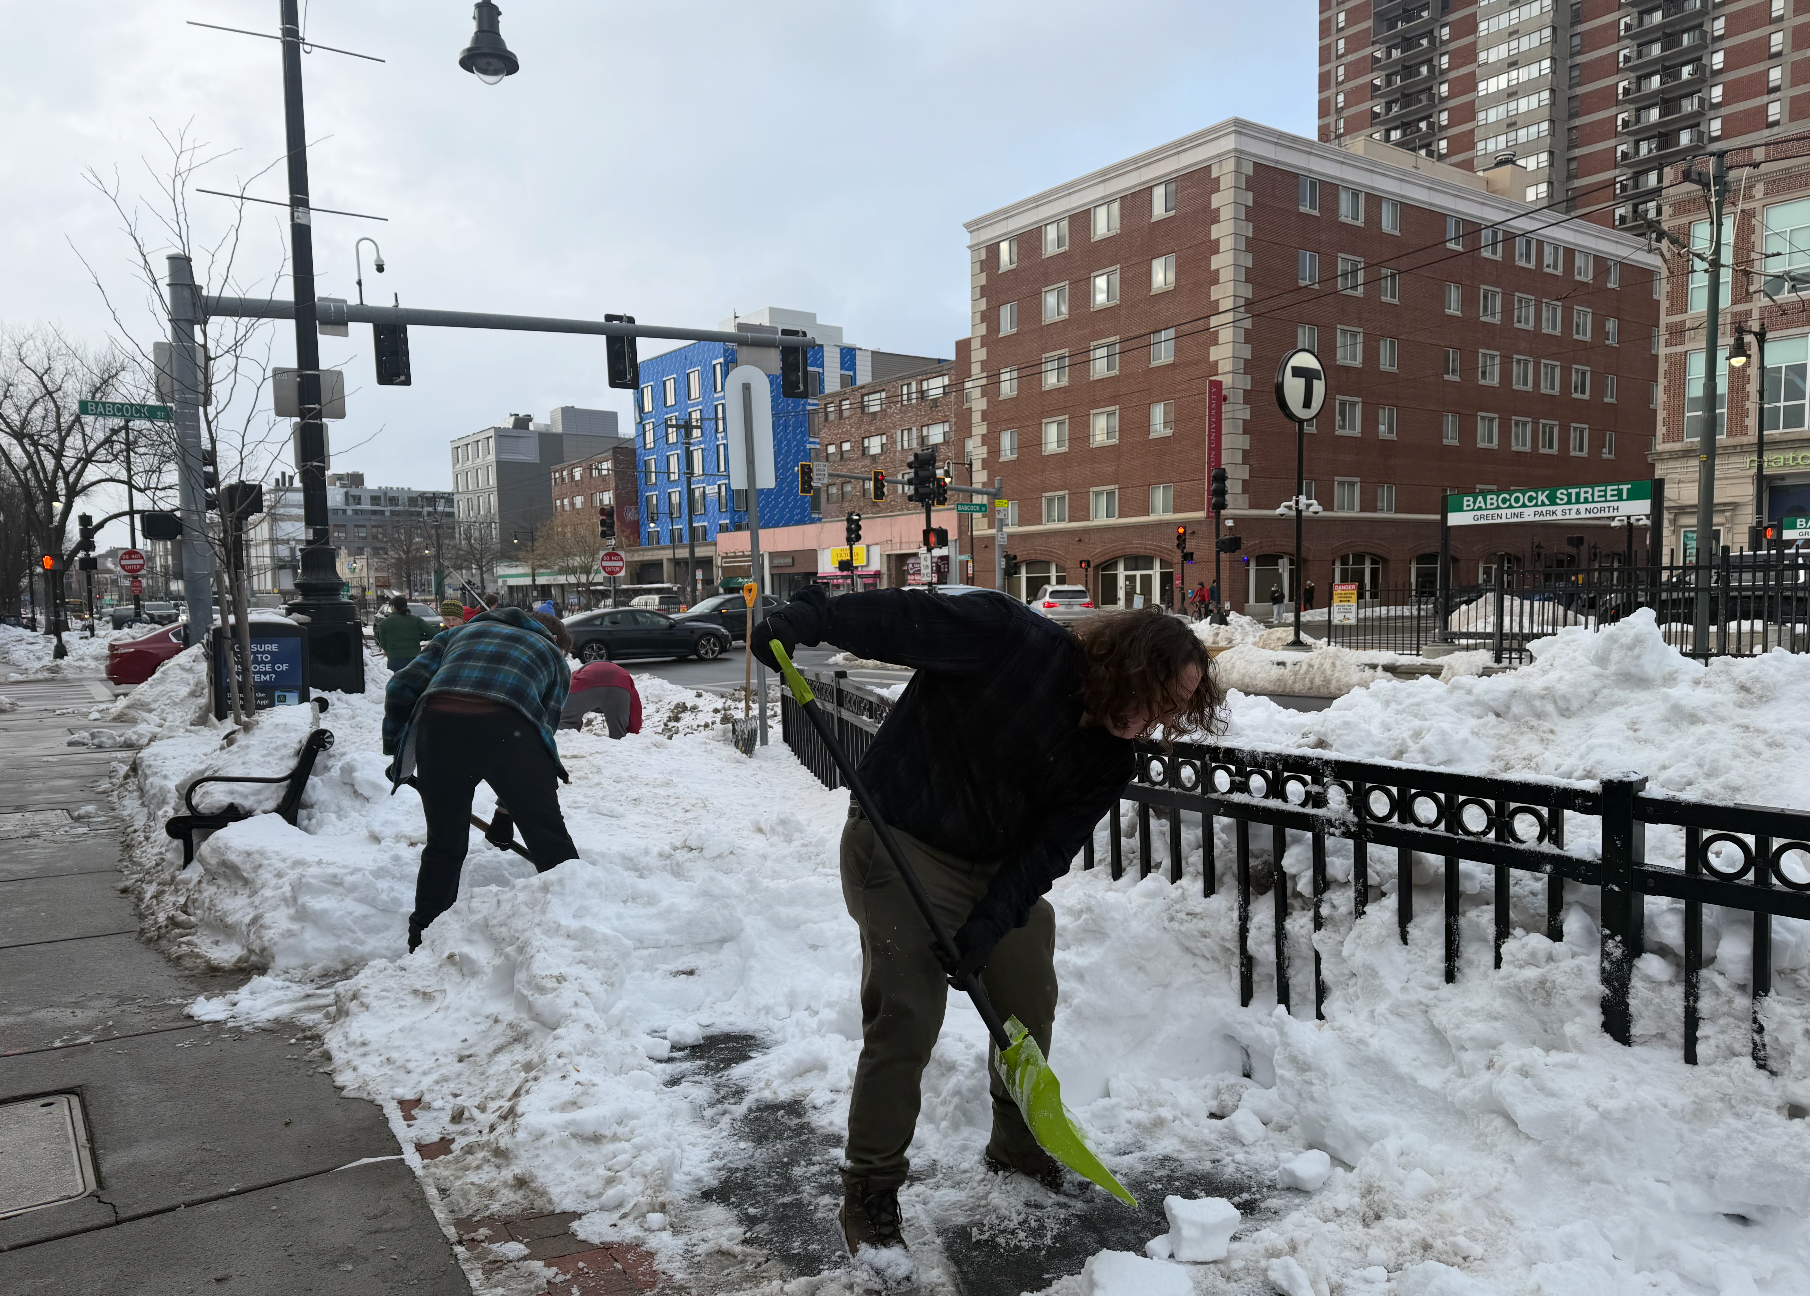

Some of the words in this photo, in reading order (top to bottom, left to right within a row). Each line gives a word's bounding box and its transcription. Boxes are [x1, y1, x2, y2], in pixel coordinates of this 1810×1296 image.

[1291, 365, 1322, 409] T
[87, 402, 149, 418] BABCOCK
[1462, 490, 1550, 511] BABCOCK
[1555, 484, 1632, 504] STREET
[1472, 512, 1503, 522] GREEN
[1505, 511, 1525, 520] LINE
[1533, 510, 1558, 518] PARK
[1561, 508, 1574, 517] ST
[1575, 507, 1582, 516] &
[1584, 505, 1620, 515] NORTH
